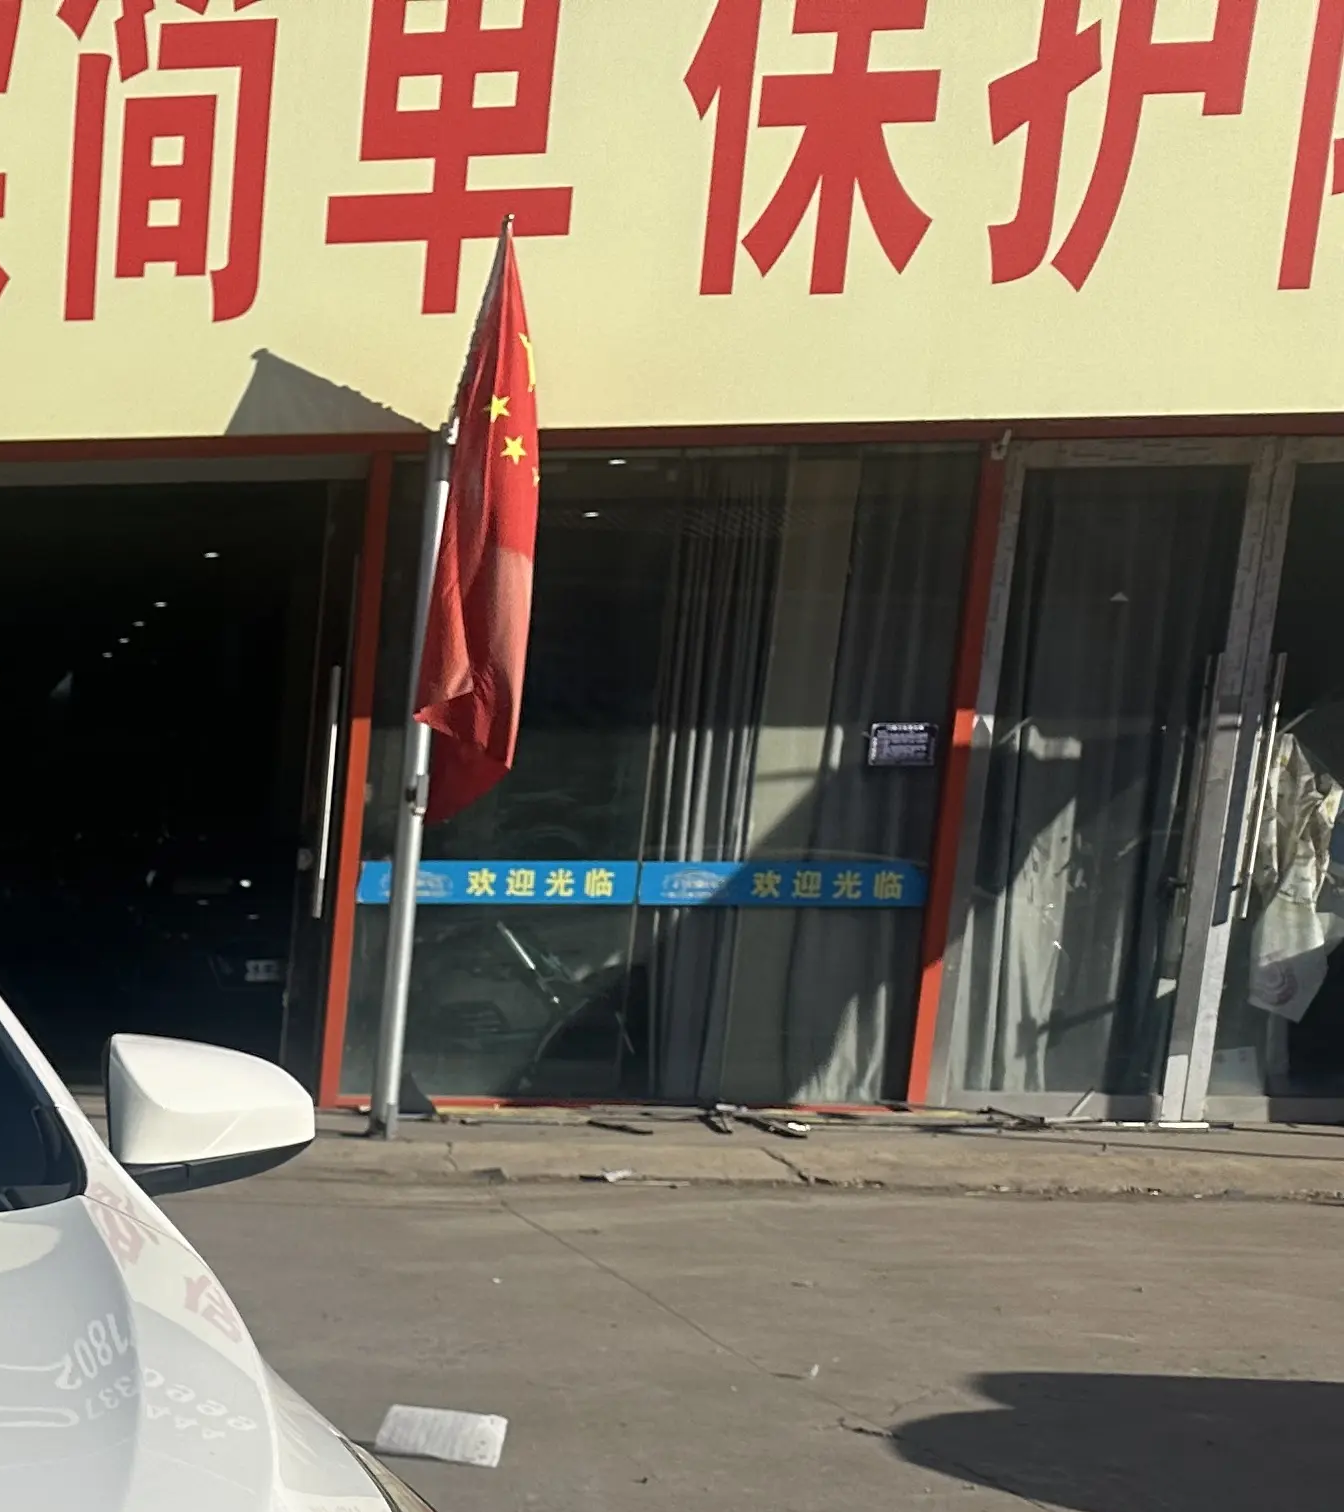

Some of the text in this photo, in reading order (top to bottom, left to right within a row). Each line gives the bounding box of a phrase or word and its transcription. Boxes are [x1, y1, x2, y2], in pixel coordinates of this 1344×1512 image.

[684, 0, 1344, 295] 保护
[466, 867, 615, 897] 欢迎光临
[752, 869, 905, 899] 欢迎光临
